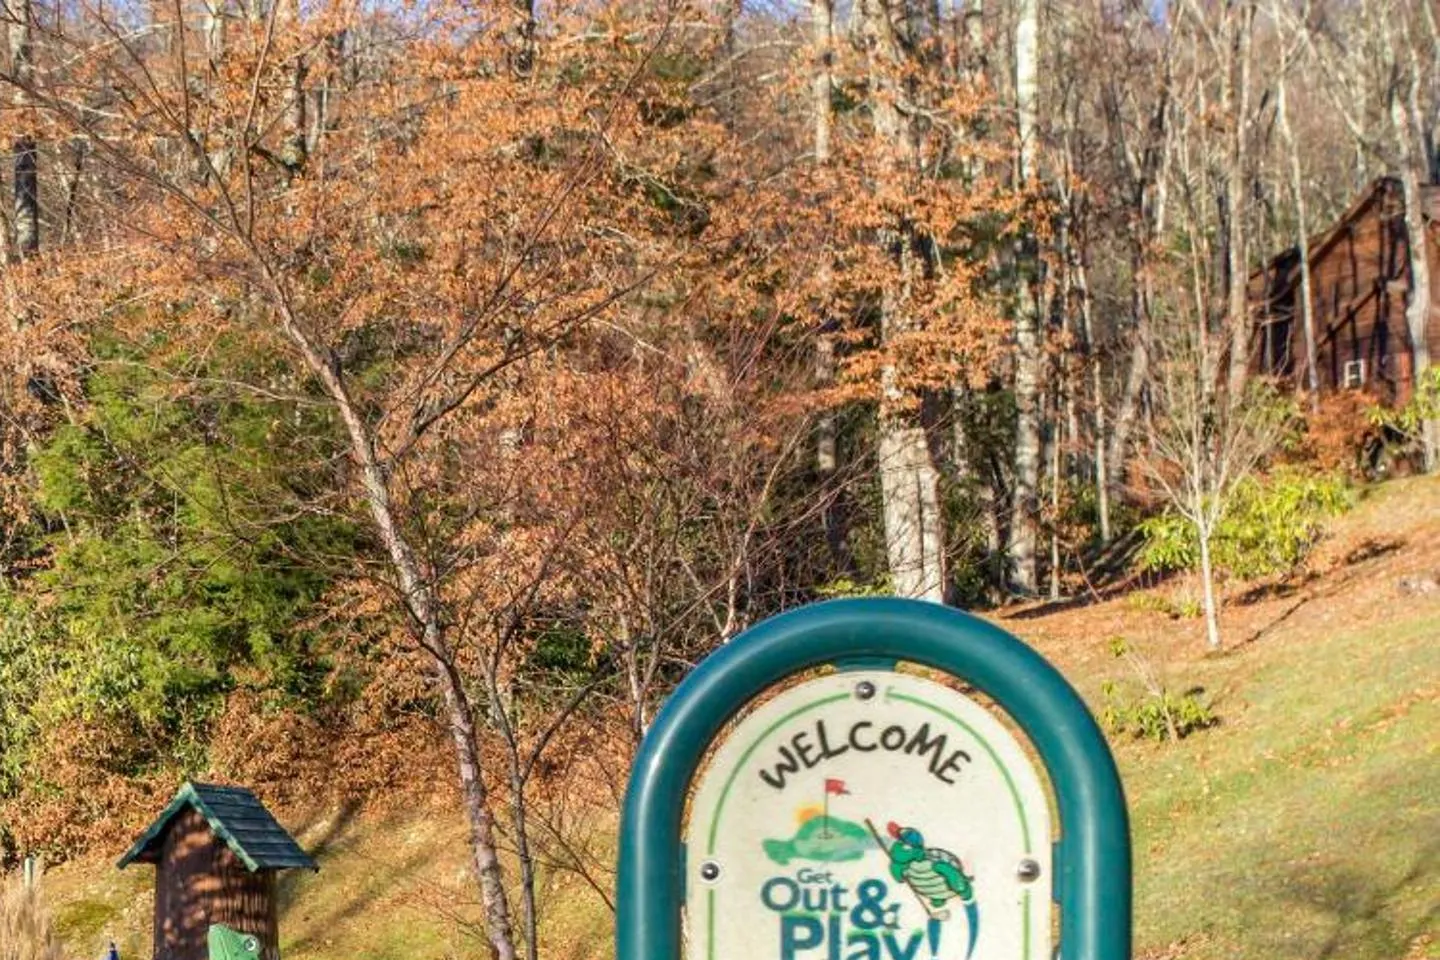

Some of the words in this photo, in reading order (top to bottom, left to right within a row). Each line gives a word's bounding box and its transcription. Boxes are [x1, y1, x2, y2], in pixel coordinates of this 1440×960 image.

[760, 720, 972, 790] WELCOME
[797, 868, 834, 885] Get
[760, 877, 849, 912] Out
[850, 878, 901, 930] &
